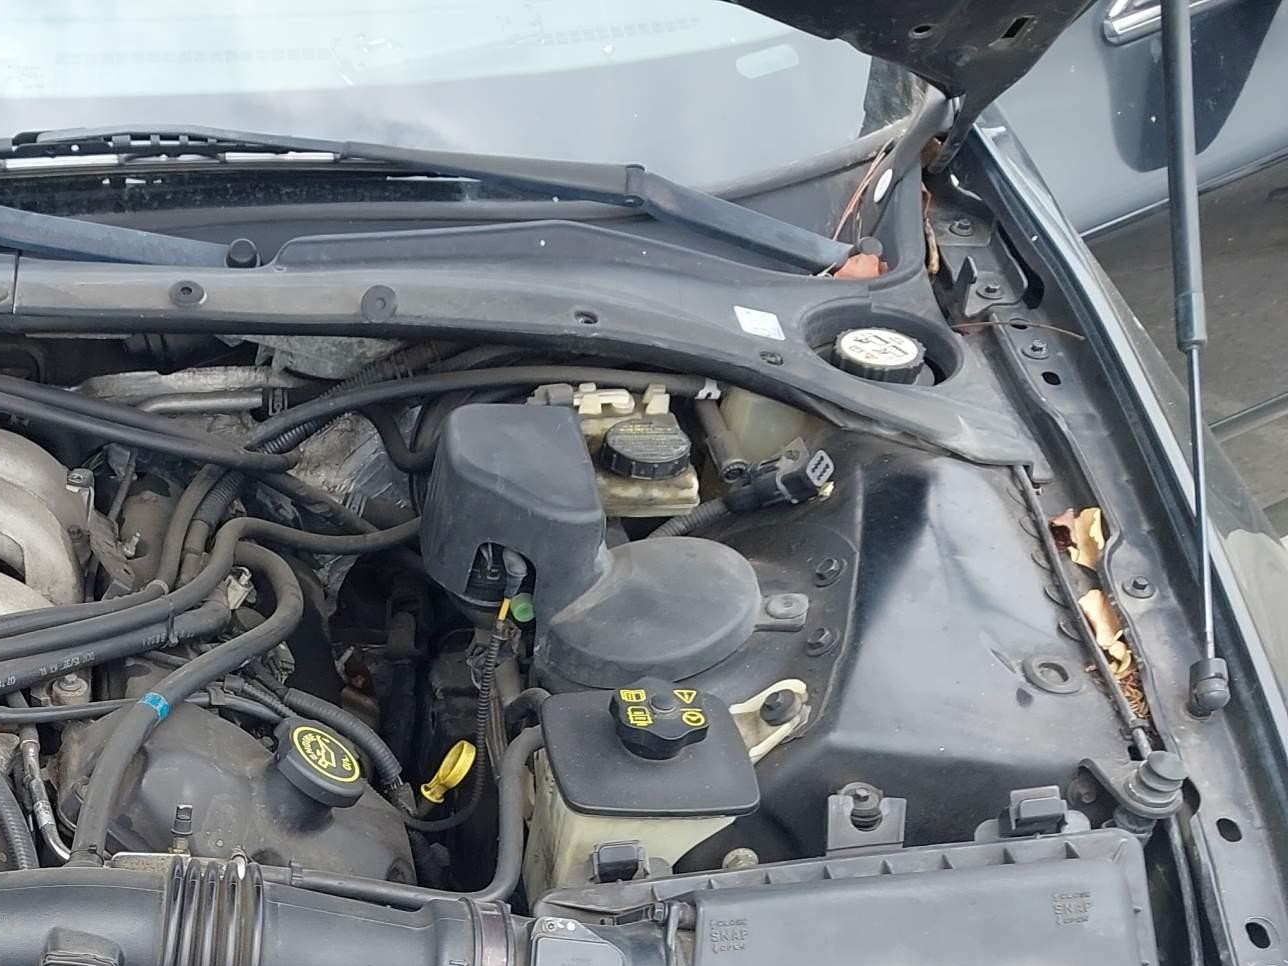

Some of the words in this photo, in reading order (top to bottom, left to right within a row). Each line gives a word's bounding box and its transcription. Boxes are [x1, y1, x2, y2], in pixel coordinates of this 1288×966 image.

[341, 754, 352, 771] OIL
[1052, 901, 1093, 915] SNAP
[710, 928, 749, 943] SNAP
